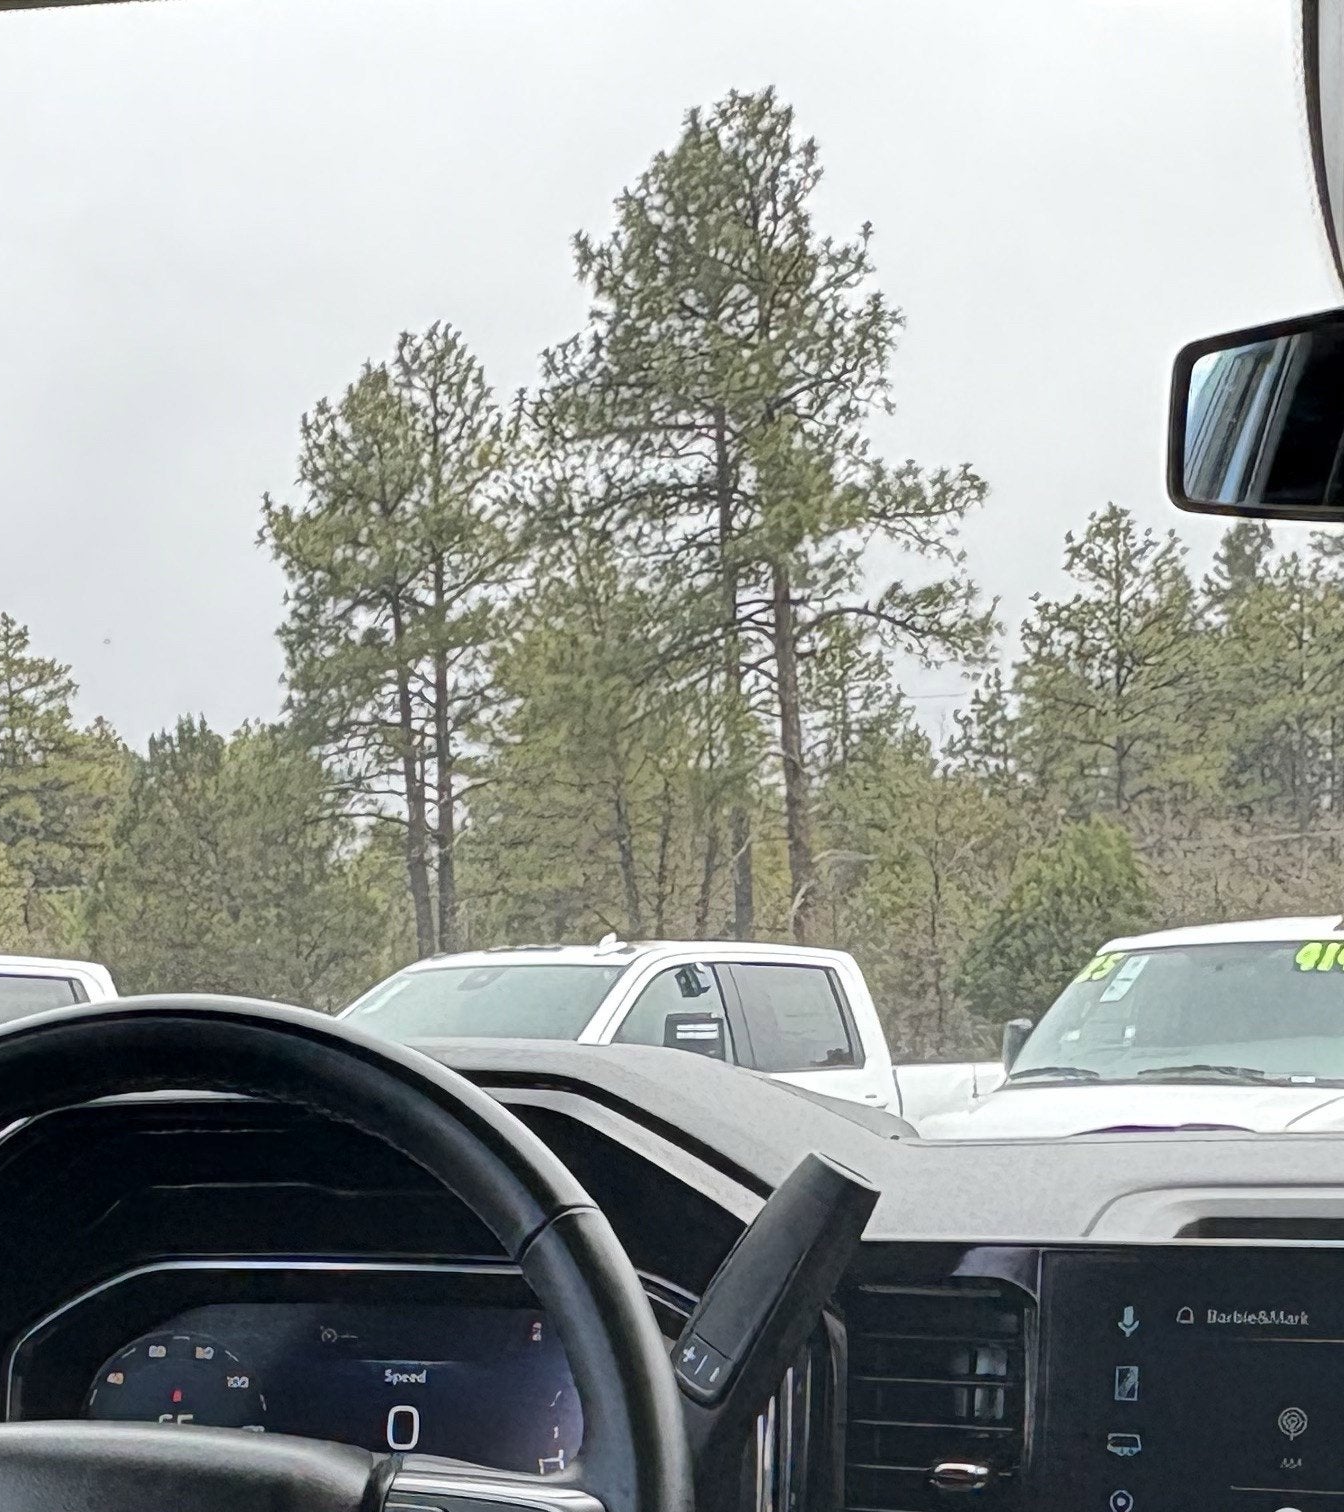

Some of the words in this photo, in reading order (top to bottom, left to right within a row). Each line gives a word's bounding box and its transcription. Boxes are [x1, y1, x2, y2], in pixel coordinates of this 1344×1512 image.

[1207, 1308, 1309, 1326] Barbie&Mark
[384, 1368, 427, 1386] Speed
[386, 1404, 420, 1451] 0
